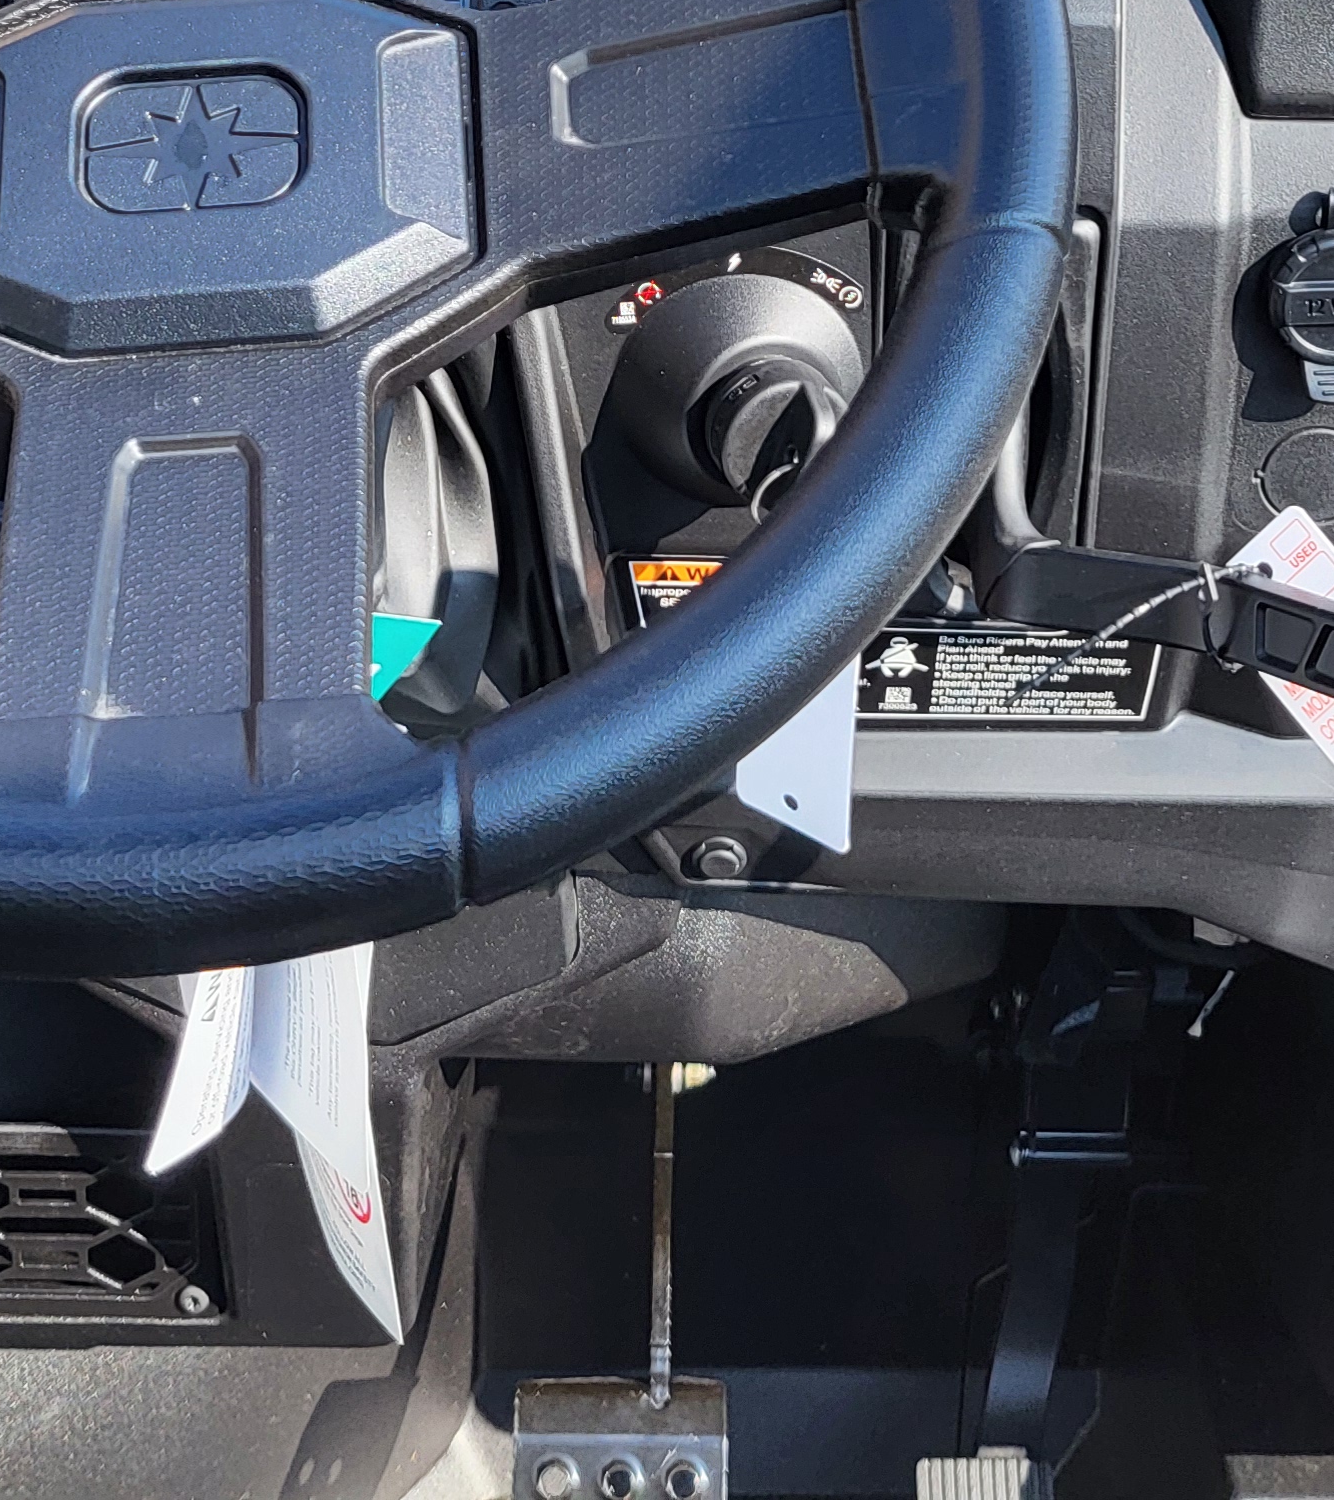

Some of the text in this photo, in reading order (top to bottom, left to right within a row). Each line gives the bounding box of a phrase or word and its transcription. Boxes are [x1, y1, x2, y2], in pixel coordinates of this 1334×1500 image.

[1304, 298, 1325, 317] 12
[1289, 541, 1317, 569] USED
[938, 635, 956, 644] Be
[956, 635, 985, 644] Sure
[985, 636, 1025, 647] Riders
[1025, 637, 1049, 649] Pay
[1104, 639, 1129, 649] and
[936, 644, 1005, 655] Plan Ahead
[935, 652, 946, 662] If
[945, 654, 969, 663] you
[969, 653, 999, 663] think
[999, 655, 1014, 664] or
[1014, 654, 1037, 664] feel
[1037, 655, 1057, 665] the
[1100, 658, 1128, 668] may
[934, 661, 952, 672] tip
[951, 663, 966, 672] or
[988, 663, 1031, 673] reduce
[1081, 665, 1095, 674] to
[941, 670, 974, 680] Keep
[983, 671, 1007, 681] firm
[1007, 672, 1032, 682] grip
[931, 679, 1017, 689] steering wheel
[930, 688, 945, 697] or
[945, 687, 1007, 698] handholds
[1031, 689, 1066, 699] brace
[938, 695, 957, 705] Do
[956, 697, 977, 706] not
[977, 697, 998, 707] put
[1020, 698, 1045, 708] part
[1045, 698, 1059, 708] of
[1059, 699, 1086, 709] your
[1086, 699, 1118, 709] body
[928, 704, 973, 713] outside
[972, 704, 987, 713] of
[988, 705, 1009, 714] the
[1008, 706, 1051, 715] vehicle
[1052, 706, 1070, 715] for
[1070, 707, 1093, 716] any
